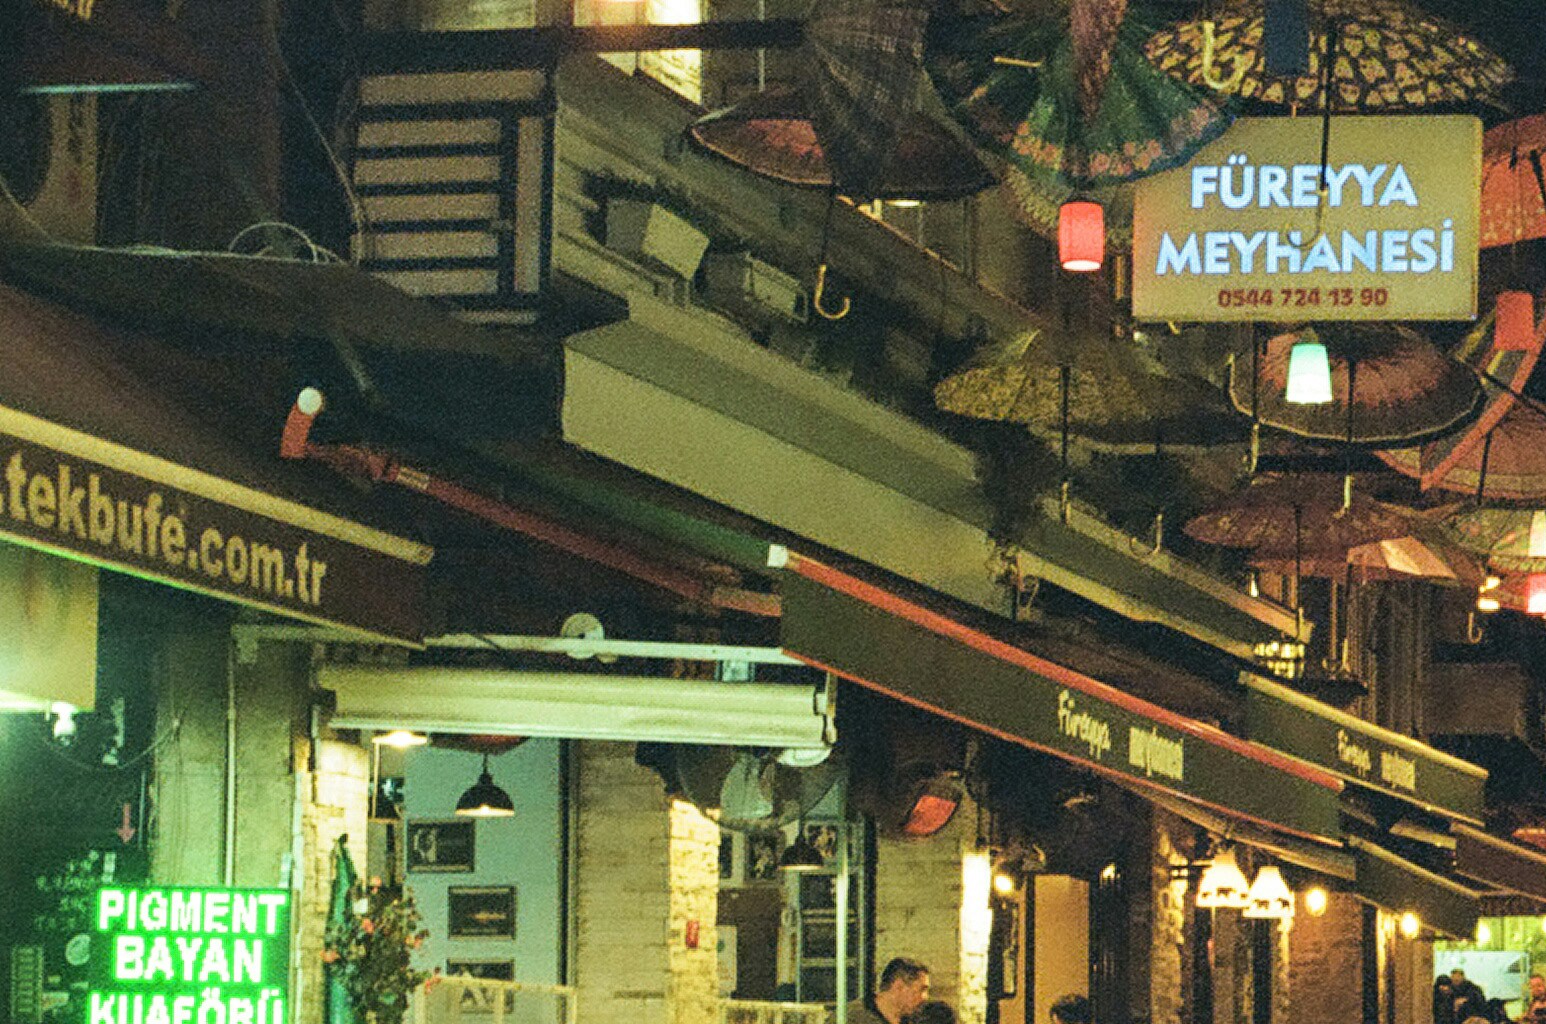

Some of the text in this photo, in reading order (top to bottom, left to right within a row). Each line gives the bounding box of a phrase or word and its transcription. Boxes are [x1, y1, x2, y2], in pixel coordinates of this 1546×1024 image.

[1191, 154, 1418, 209] FÜREYYA
[1155, 219, 1454, 275] MEYHANESİ
[1218, 288, 1388, 307] 0544 724 13 90
[97, 888, 288, 936] PIGMENT
[113, 933, 264, 984] BAYAN
